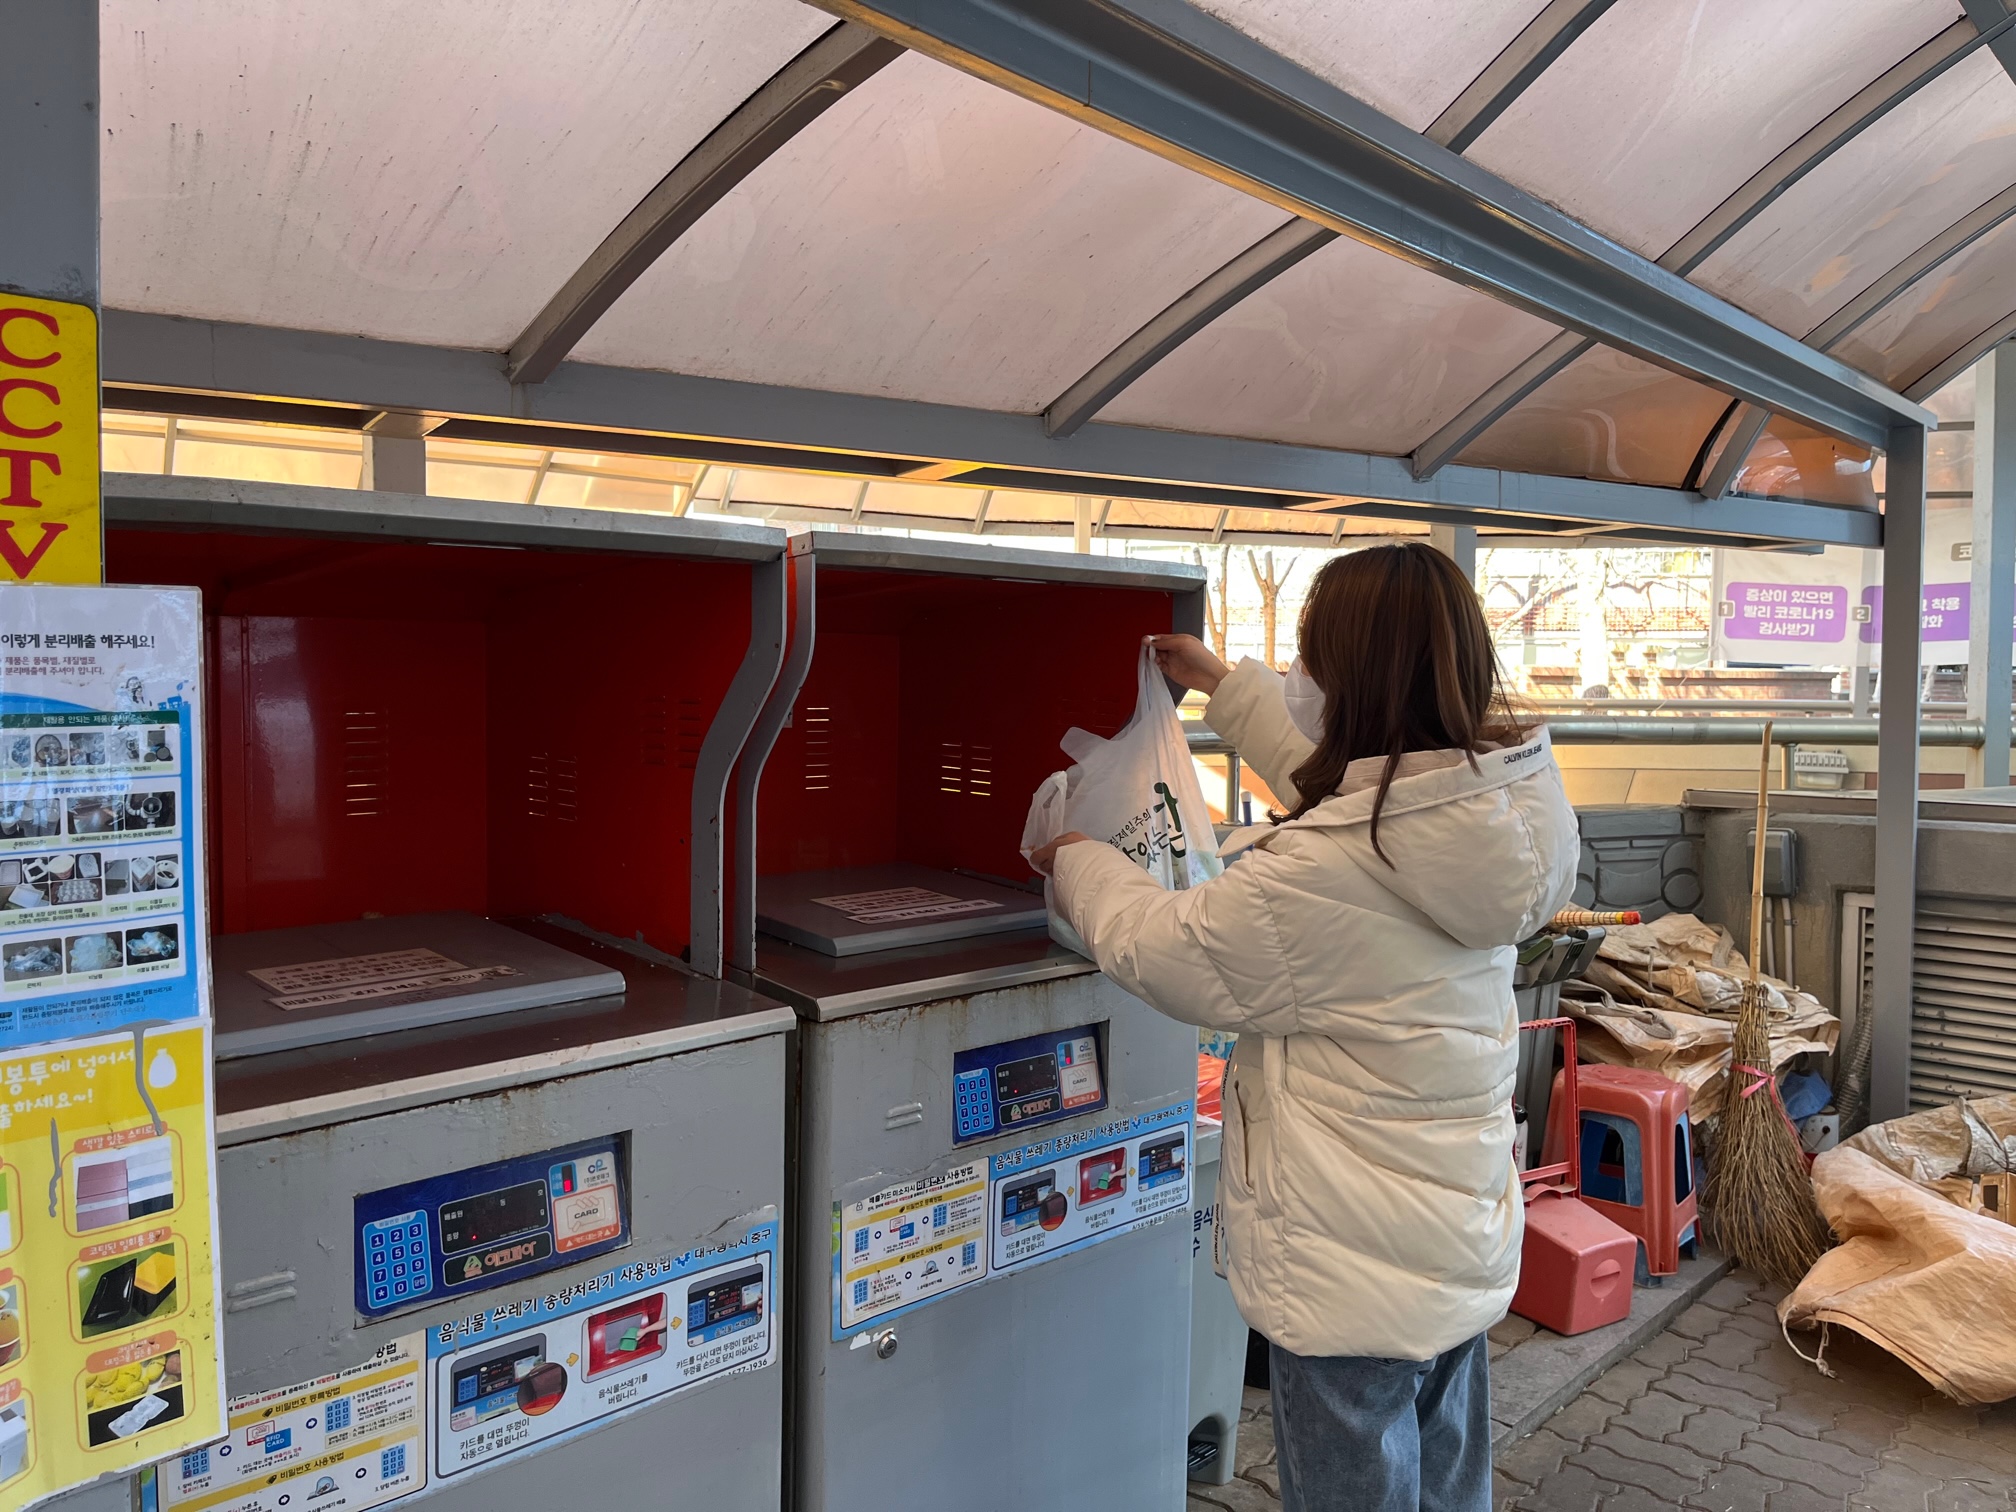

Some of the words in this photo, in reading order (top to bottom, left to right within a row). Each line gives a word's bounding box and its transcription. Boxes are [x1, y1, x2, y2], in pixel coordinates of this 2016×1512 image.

[0, 308, 68, 579] CCTV
[1746, 588, 1787, 603] 증상이
[1791, 590, 1834, 605] 있으면
[1743, 605, 1771, 618] 빨리
[1774, 606, 1834, 621] 코로나19
[1759, 621, 1815, 637] 검사받기
[1, 633, 40, 648] 이렇게
[44, 633, 96, 649] 분리배출
[100, 633, 155, 649] 해주세요!
[1504, 752, 1522, 764] CALVIN
[0, 1059, 70, 1095] 봉투에
[128, 1125, 157, 1138] 스티로
[995, 1152, 1022, 1171] 음식물
[1026, 1142, 1051, 1158] 쓰레기
[1055, 1128, 1096, 1153] 중량처리기
[1100, 1119, 1130, 1138] 사용방법
[574, 1208, 599, 1219] CARD
[90, 1242, 116, 1256] 코팅된
[120, 1235, 144, 1251] 일회용
[374, 1237, 381, 1246] 1
[393, 1232, 400, 1240] 2
[412, 1226, 419, 1235] 3
[375, 1254, 382, 1262] 4
[395, 1249, 401, 1257] 5
[413, 1243, 420, 1252] 6
[377, 1271, 383, 1280] 7
[396, 1266, 403, 1274] 8
[415, 1261, 421, 1269] 9
[398, 1283, 404, 1292] 0
[438, 1312, 486, 1343] 음식물
[493, 1299, 538, 1323] 쓰레기
[676, 1355, 695, 1369] 카드를
[696, 1351, 709, 1361] 다시
[710, 1345, 722, 1356] 대면
[723, 1338, 741, 1352] 뚜껑이
[683, 1364, 702, 1377] 뚜껑을
[703, 1357, 721, 1370] 손으로
[722, 1351, 735, 1363] 닫지
[728, 1359, 768, 1375] 577-1936
[599, 1373, 648, 1399] 음식물쓰레기를
[275, 1398, 306, 1413] 비밀번호
[309, 1386, 341, 1403] 등록방법
[608, 1388, 639, 1404] 버립니다.
[266, 1433, 281, 1441] RFID
[266, 1438, 285, 1447] CARD
[460, 1434, 485, 1450] 카드를
[487, 1426, 504, 1440] 대면
[506, 1417, 530, 1433] 뚜껑이
[460, 1443, 493, 1461] 자동으로
[496, 1429, 530, 1448] 열립니다.
[280, 1463, 311, 1479] 비밀번호
[314, 1452, 345, 1467] 사용방법
